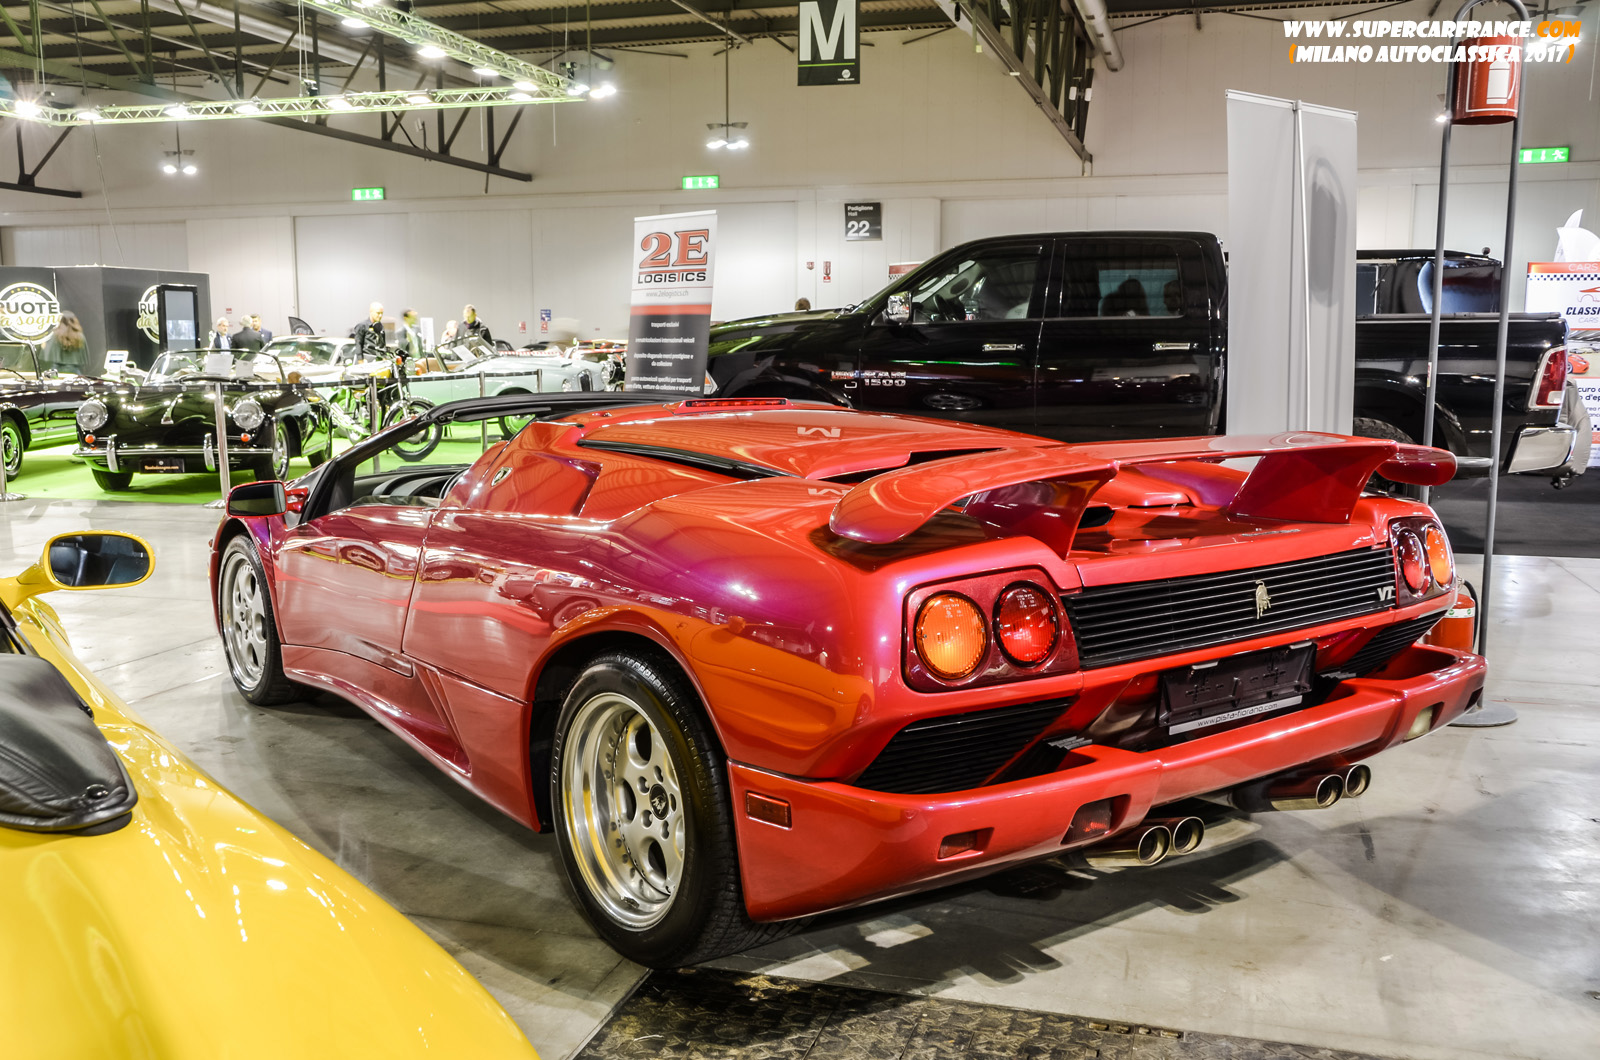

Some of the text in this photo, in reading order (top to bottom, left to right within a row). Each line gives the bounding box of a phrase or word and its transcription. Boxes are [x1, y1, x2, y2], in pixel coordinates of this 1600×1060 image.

[799, 0, 857, 61] M
[847, 220, 870, 237] 22
[639, 229, 709, 269] 2E
[1568, 262, 1599, 272] CARS
[638, 270, 706, 284] LOGISTICS
[864, 379, 906, 387] 1500
[1377, 586, 1396, 601] VT
[1197, 703, 1278, 727] www.pista-fiorano.com
